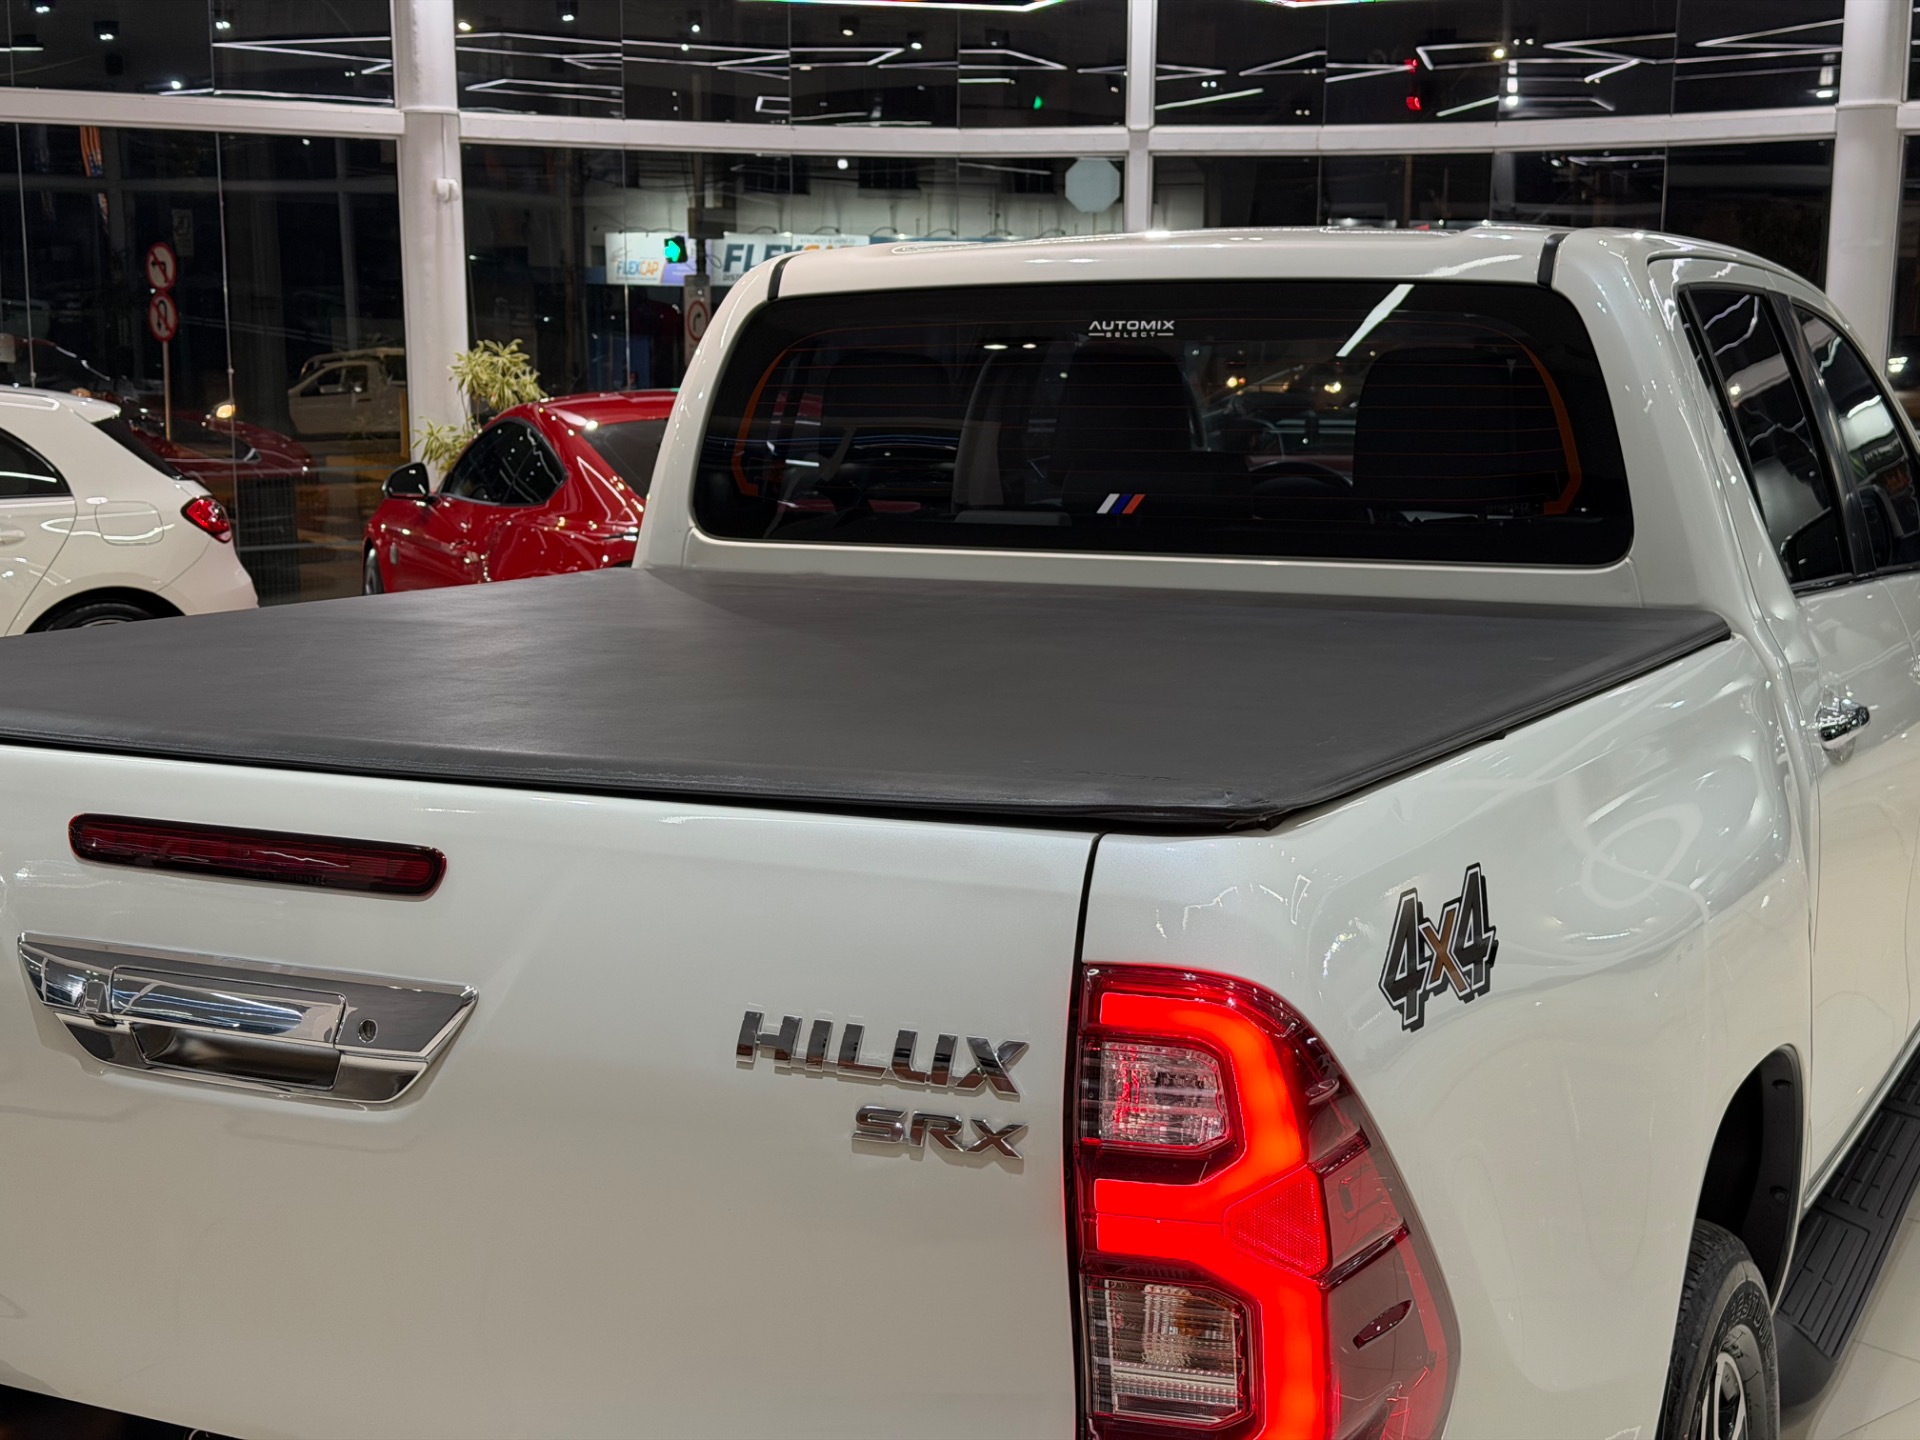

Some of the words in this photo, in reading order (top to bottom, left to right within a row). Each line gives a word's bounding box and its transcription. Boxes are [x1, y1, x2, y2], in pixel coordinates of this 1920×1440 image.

[1088, 320, 1175, 331] AUTOMIX
[735, 1009, 1030, 1097] HILUX
[851, 1105, 1029, 1160] SRX
